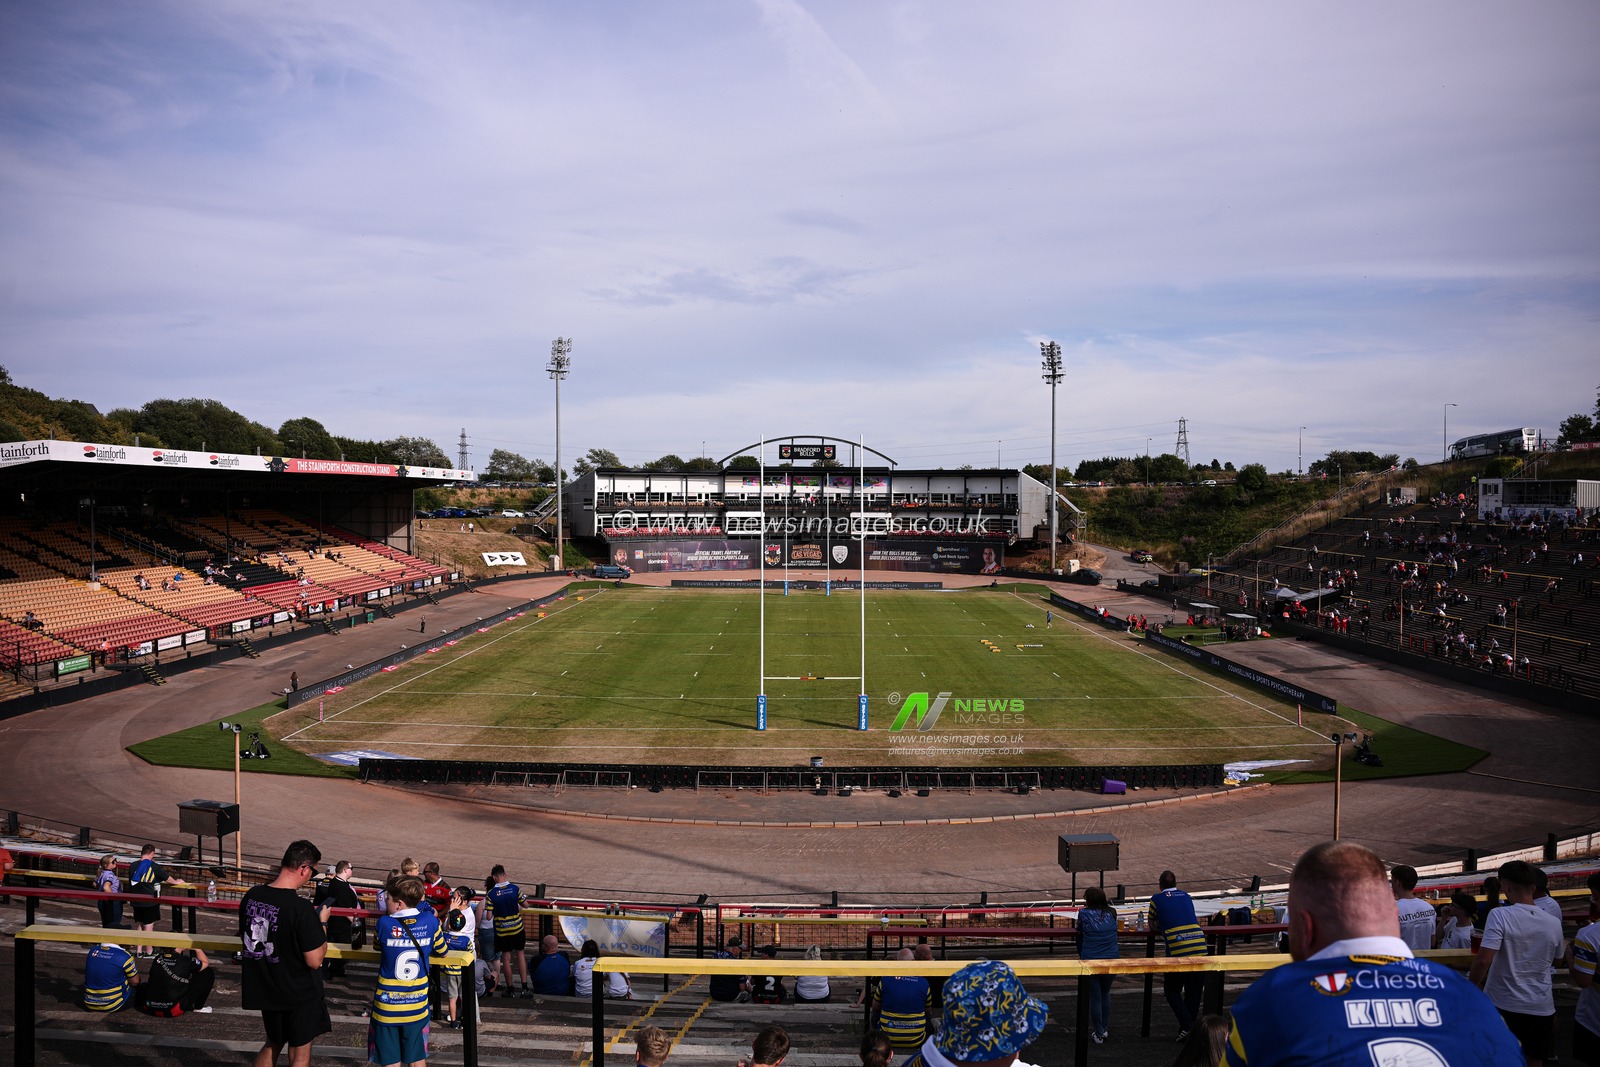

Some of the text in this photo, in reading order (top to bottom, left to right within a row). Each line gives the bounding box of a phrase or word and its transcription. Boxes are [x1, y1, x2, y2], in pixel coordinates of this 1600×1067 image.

[297, 461, 391, 475] THE STAINFORTH CONSTRUCTION STAND
[793, 550, 821, 558] LAS VEGAS
[353, 664, 382, 680] PSYCHOTHERAPY
[1227, 664, 1252, 680] COUNSELLING
[1256, 675, 1270, 687] SPORTS
[1270, 681, 1306, 700] PSYCHOTHERAPY
[246, 904, 279, 923] SOUNDS
[248, 899, 280, 912] SWOOSH
[395, 949, 420, 981] 6
[764, 976, 775, 991] 2
[1355, 970, 1445, 989] Chester
[1344, 998, 1442, 1028] KING
